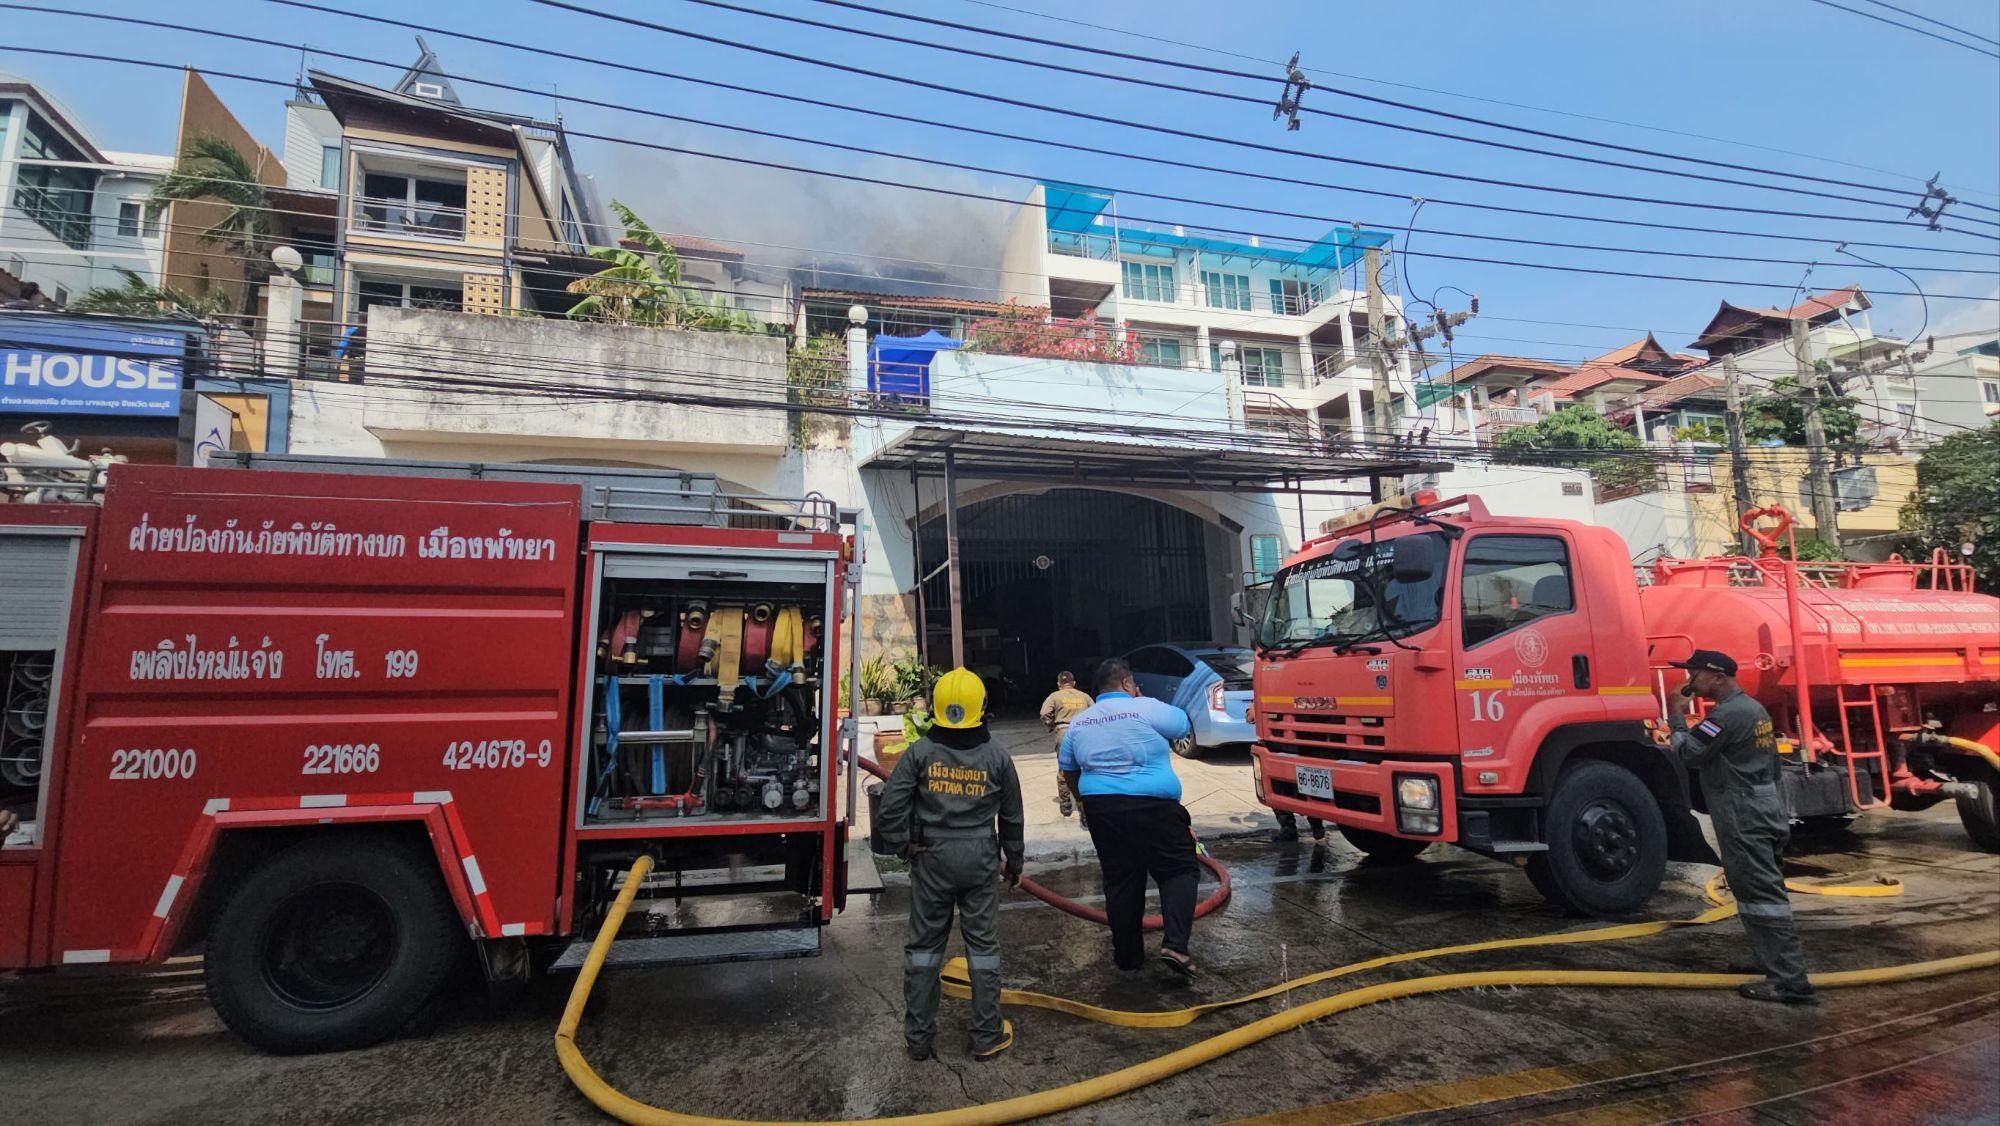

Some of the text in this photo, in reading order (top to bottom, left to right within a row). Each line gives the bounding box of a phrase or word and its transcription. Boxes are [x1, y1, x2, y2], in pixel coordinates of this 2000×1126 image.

[4, 353, 179, 390] HOUSE
[129, 512, 555, 561] ฝ่ายป้องกันภัยพิบัติทางบก เมืองพัทยา
[130, 634, 418, 680] เพลิงไหม้แจ้ง โทร. 199
[1468, 689, 1504, 721] 16
[109, 739, 552, 780] 221000 221666 424678-9
[928, 761, 988, 782] เมืองพัทยา
[928, 780, 986, 797] PATTAYA CITY
